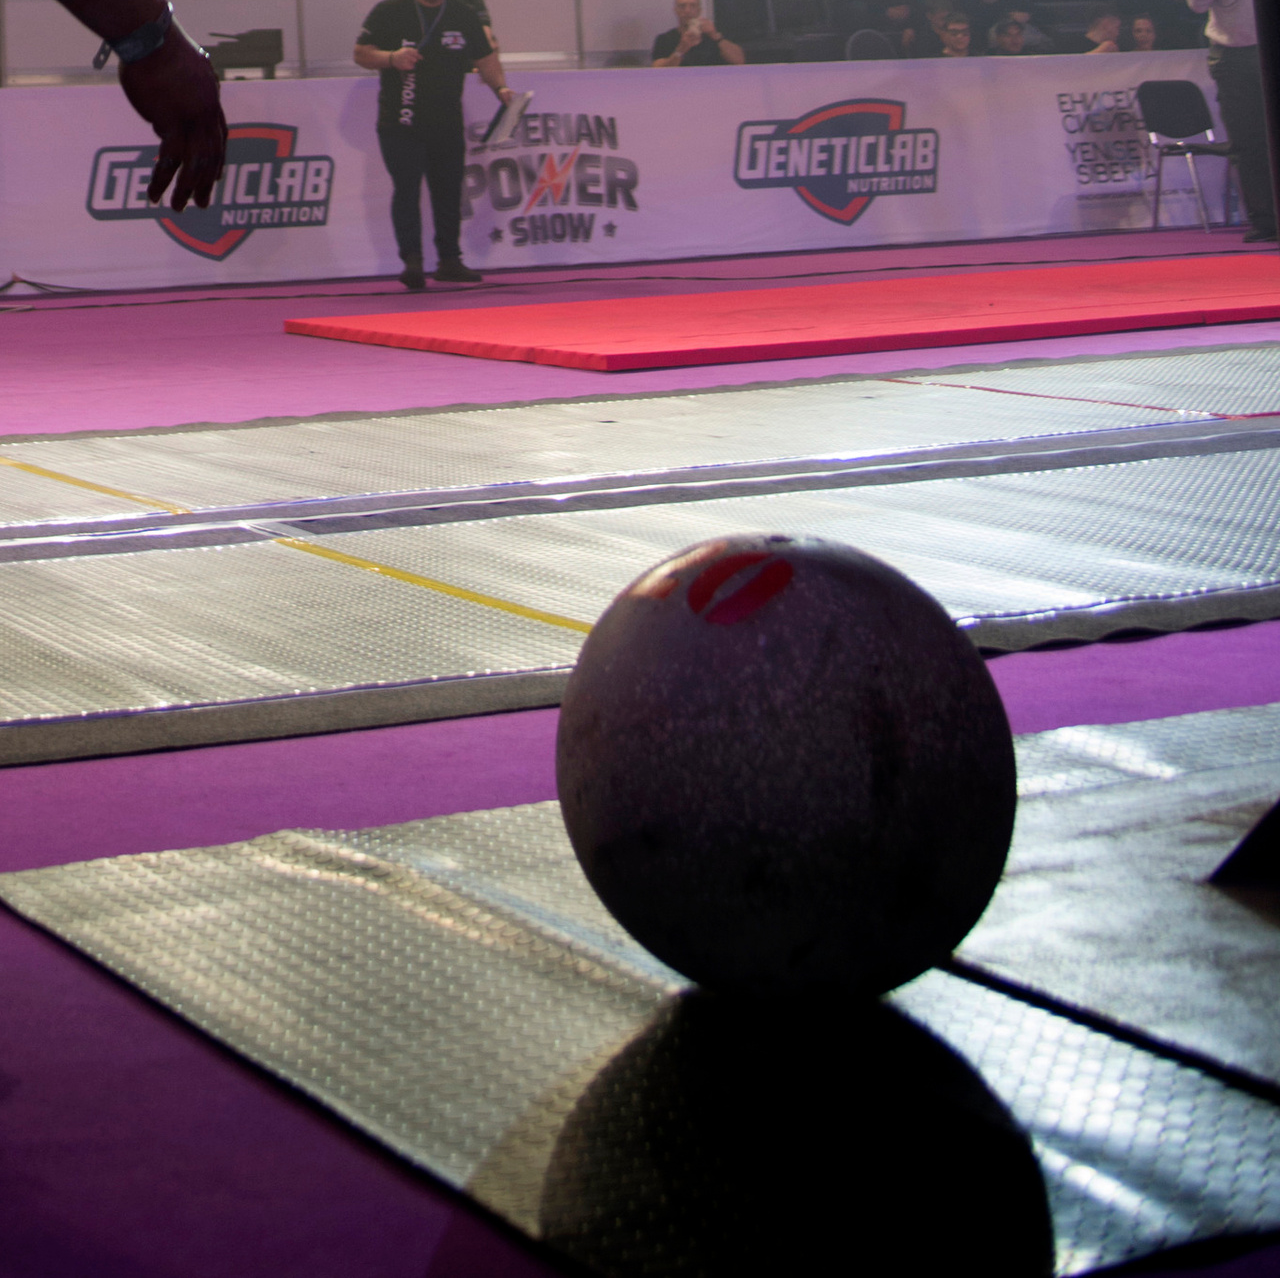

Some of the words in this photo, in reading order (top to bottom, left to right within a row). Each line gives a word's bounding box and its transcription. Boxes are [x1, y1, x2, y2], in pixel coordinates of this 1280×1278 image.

[737, 124, 936, 180] GENETICLAB
[461, 152, 639, 221] POWER
[846, 174, 934, 194] NUTRITION
[221, 206, 326, 227] NUTRITION
[509, 212, 596, 247] SHOW
